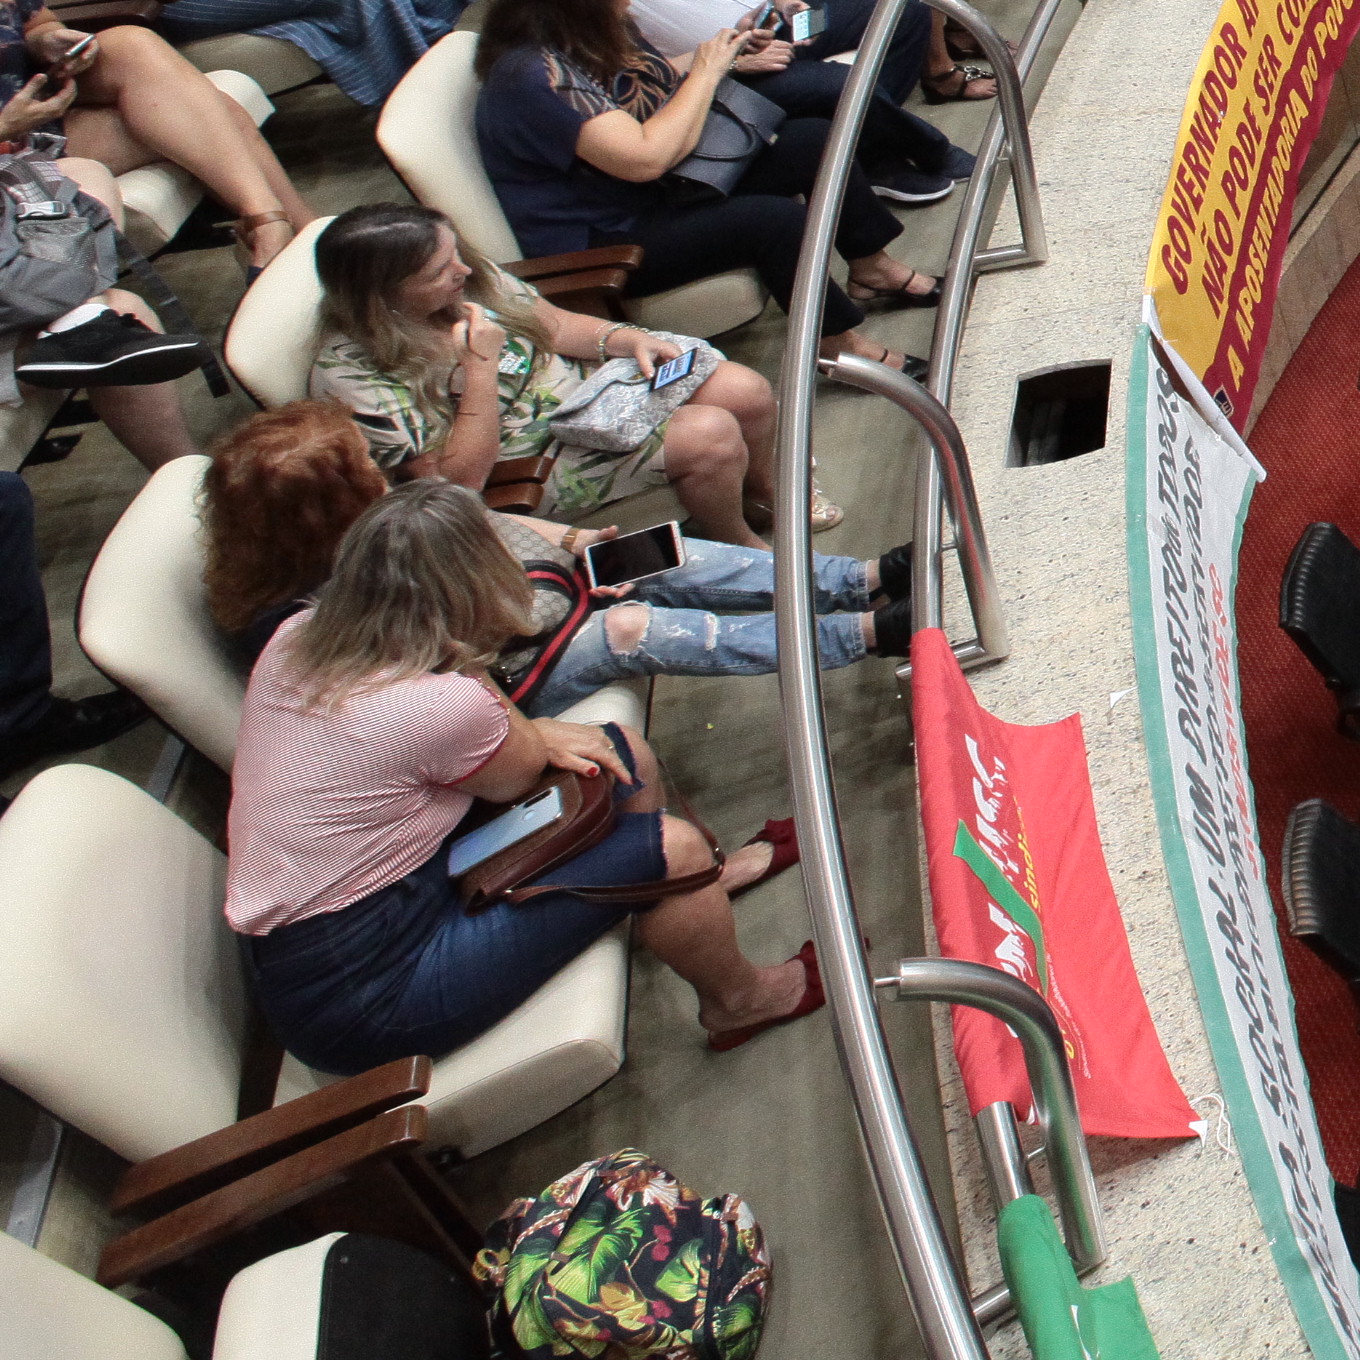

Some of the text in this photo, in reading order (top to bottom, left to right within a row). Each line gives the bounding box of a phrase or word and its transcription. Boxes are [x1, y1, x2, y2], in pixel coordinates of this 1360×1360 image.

[1160, 22, 1247, 296] GOVERNADOR
[1201, 216, 1233, 321] NÃO
[1220, 103, 1264, 216] PODE
[1252, 36, 1283, 117] SER
[1301, 53, 1320, 94] DO
[1233, 87, 1306, 347] APOSENTADORIA
[1227, 342, 1247, 394] A
[1161, 533, 1208, 764] DIREITO
